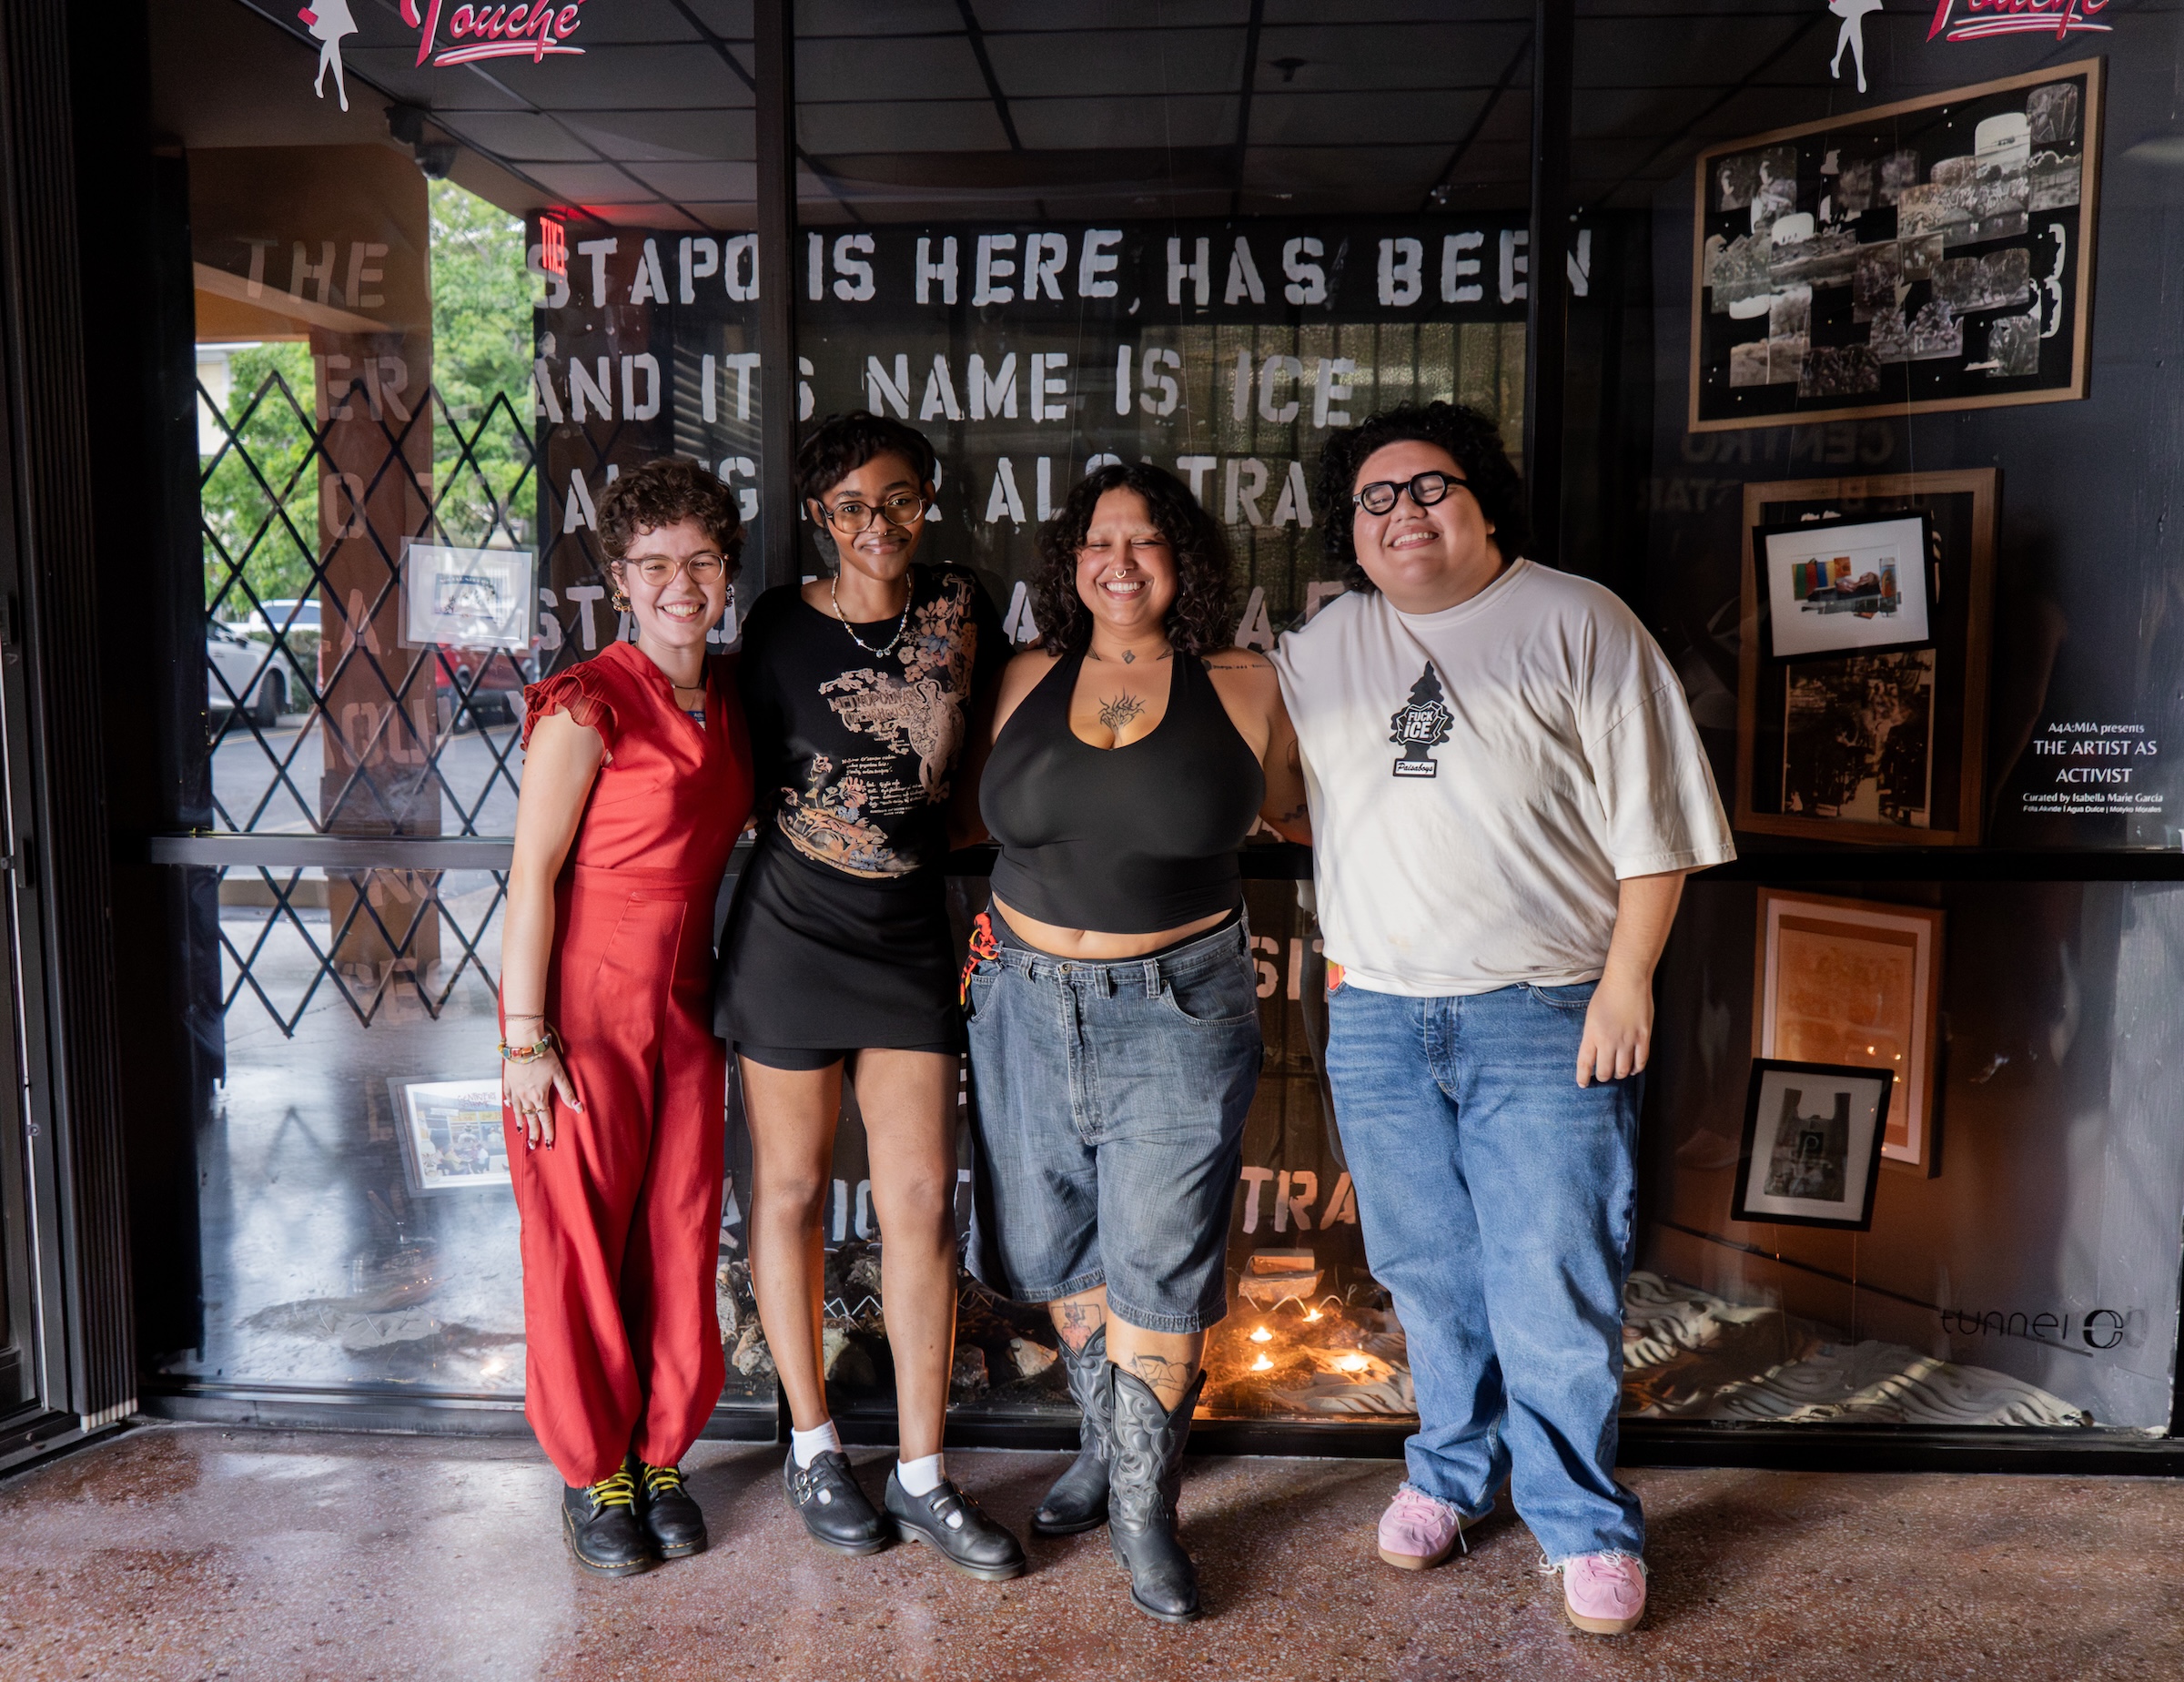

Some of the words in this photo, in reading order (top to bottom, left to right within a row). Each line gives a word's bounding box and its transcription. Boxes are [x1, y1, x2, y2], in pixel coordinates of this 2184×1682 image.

[234, 239, 389, 309] THE
[807, 232, 876, 302] IS
[1166, 236, 1328, 307] HAS
[865, 351, 1068, 420] NAME
[1115, 344, 1181, 417] IS
[1234, 350, 1354, 429] ICE
[1408, 711, 1433, 722] FUCK
[2100, 723, 2145, 735] presents
[2033, 740, 2068, 755] THE
[2070, 740, 2132, 755] ARTIST
[2134, 740, 2159, 755] AS
[2055, 767, 2133, 783] ACTIVIST
[2022, 792, 2058, 803] Curated
[2059, 792, 2071, 804] by
[2072, 792, 2106, 803] Isabella
[2107, 792, 2133, 803] Marie
[1940, 1308, 2068, 1340] tunnel
